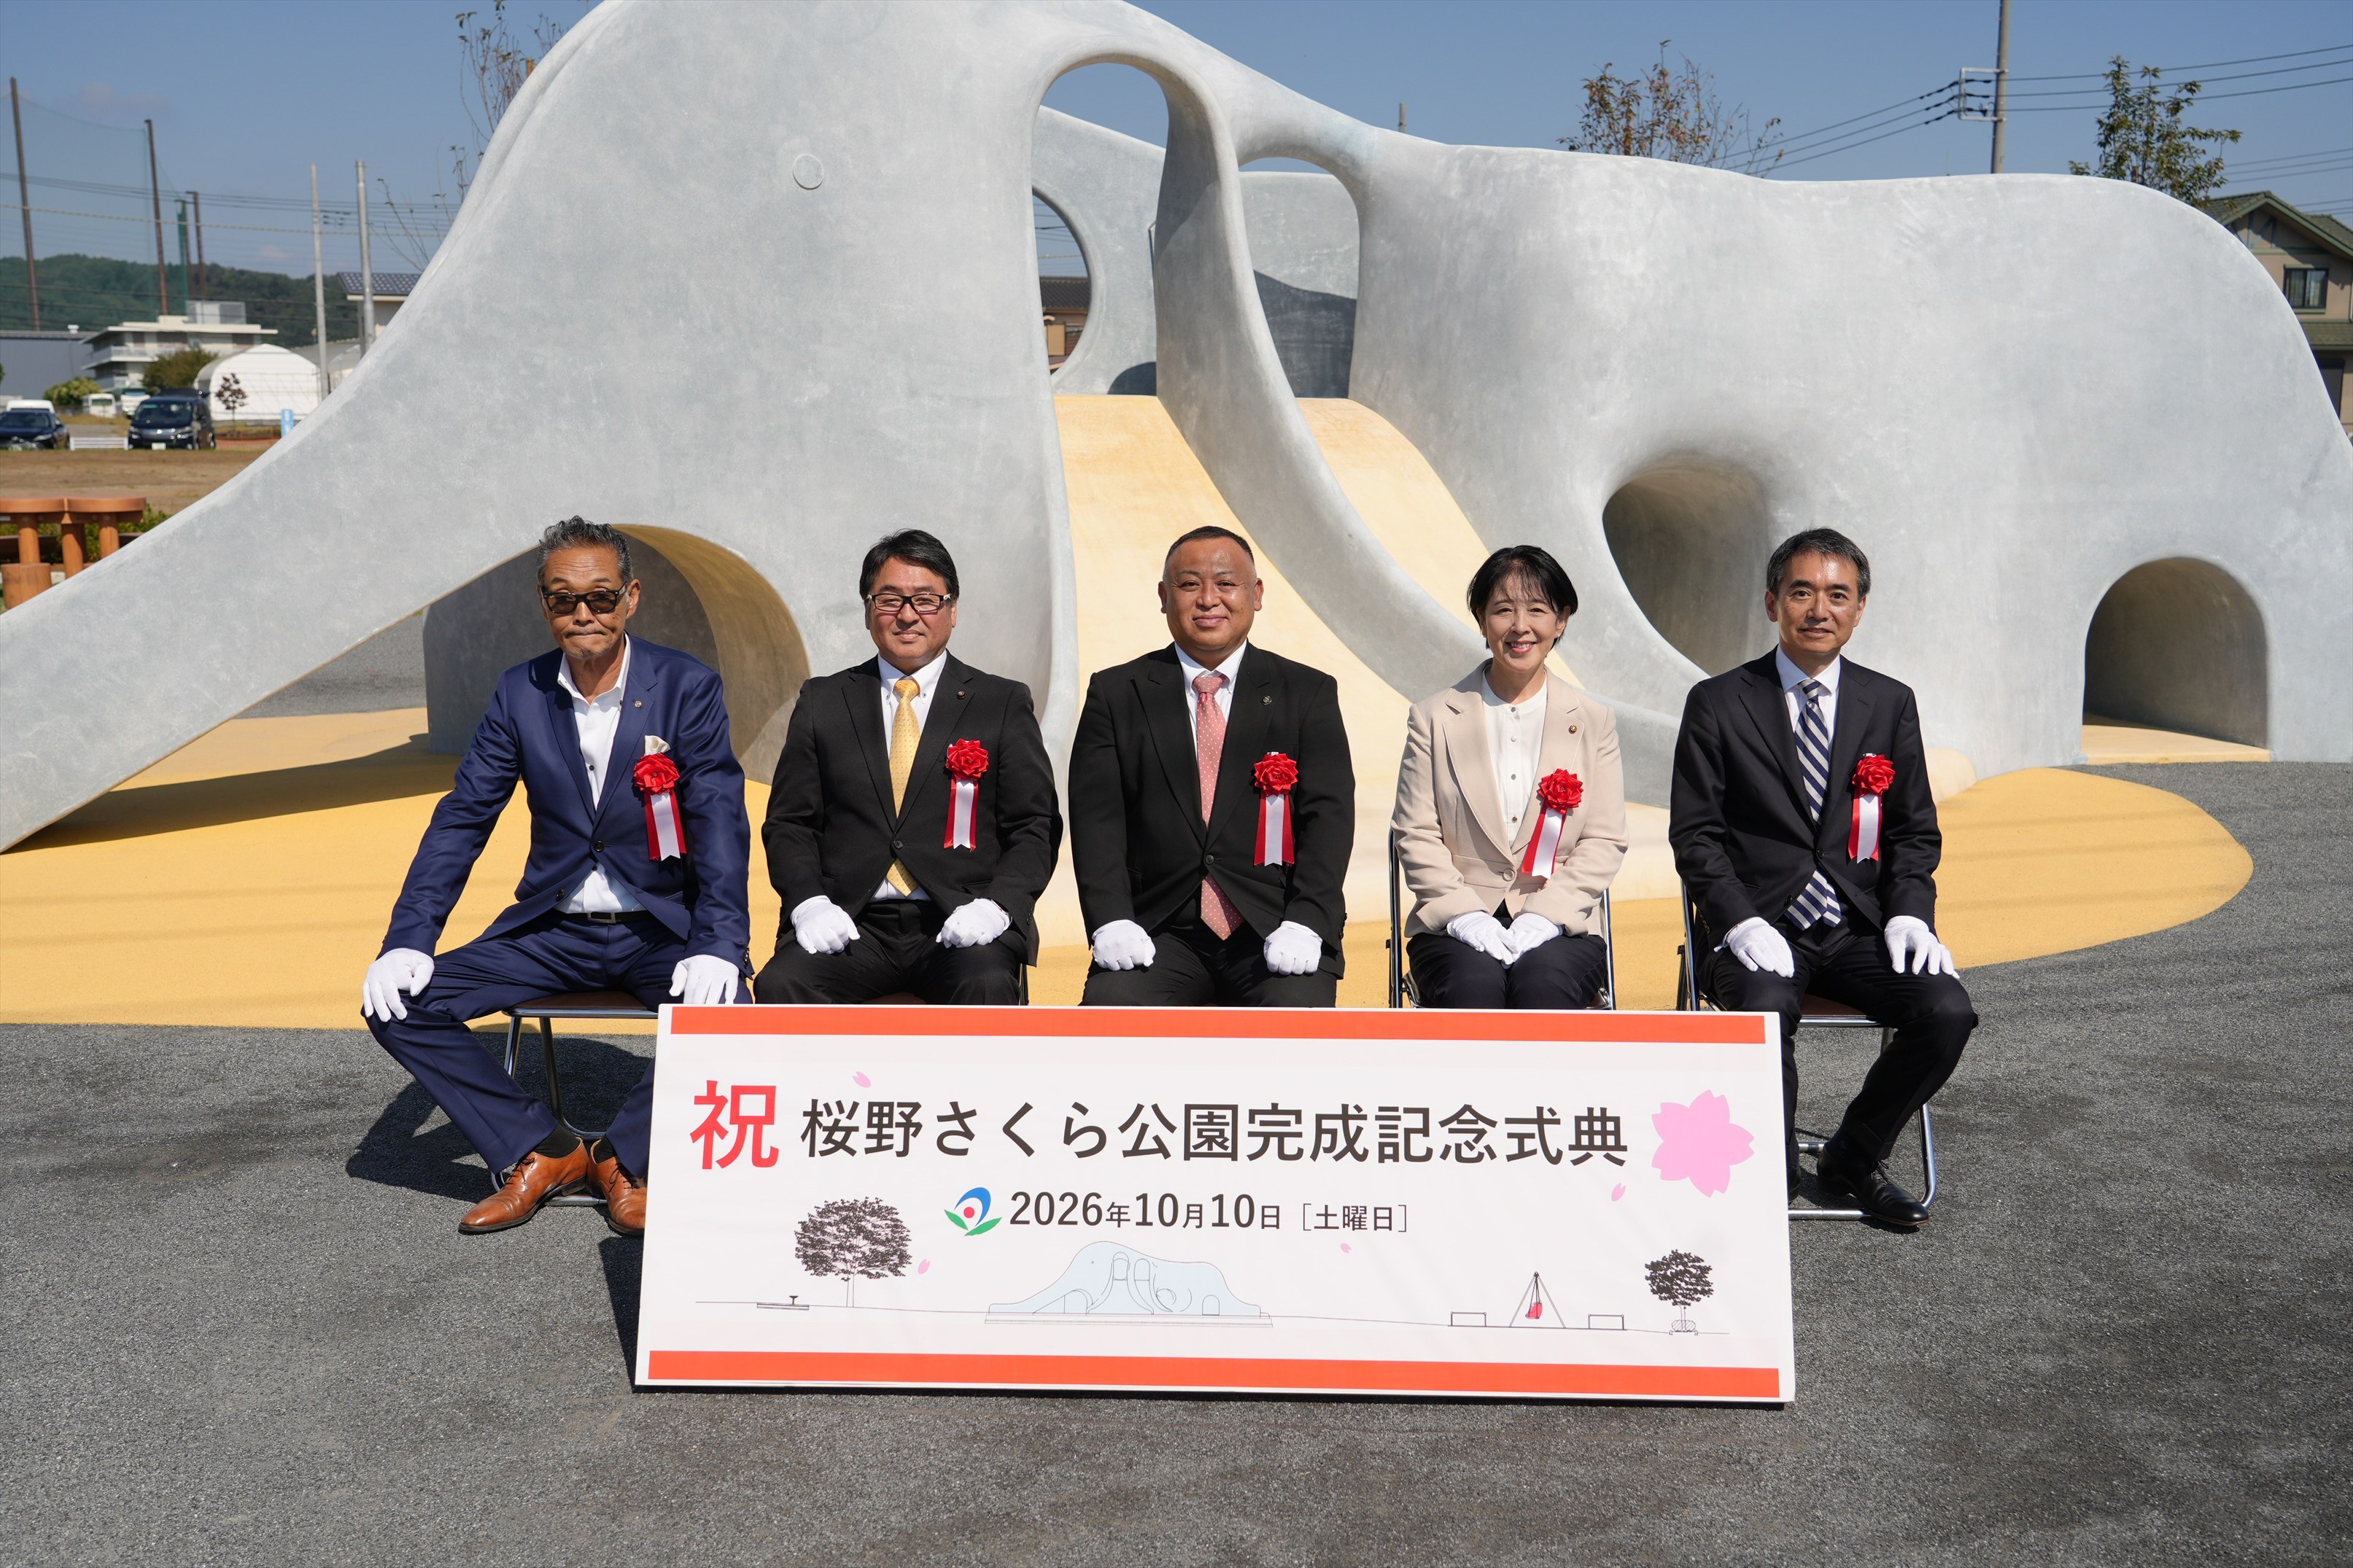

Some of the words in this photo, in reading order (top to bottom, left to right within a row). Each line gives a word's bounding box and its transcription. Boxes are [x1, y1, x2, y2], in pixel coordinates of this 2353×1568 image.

[690, 1080, 779, 1170] 祝
[800, 1098, 1628, 1167] 桜野さくら公園完成記念式典
[1009, 1191, 1280, 1231] 2026年10月10日
